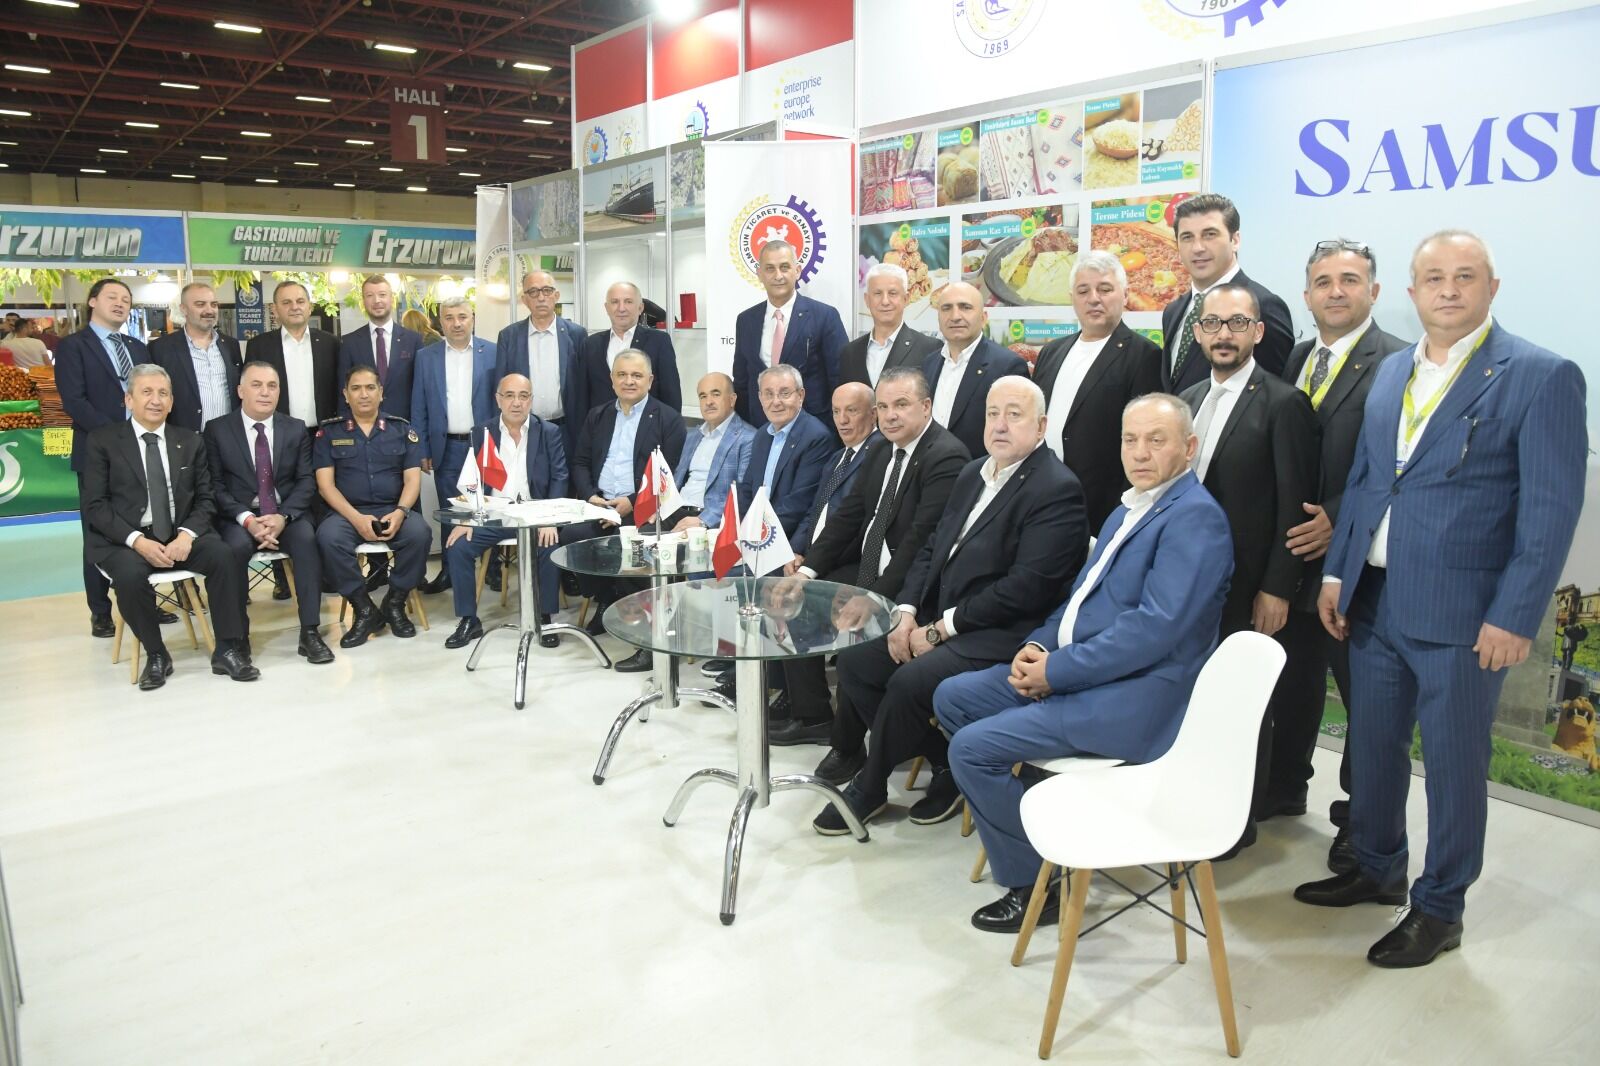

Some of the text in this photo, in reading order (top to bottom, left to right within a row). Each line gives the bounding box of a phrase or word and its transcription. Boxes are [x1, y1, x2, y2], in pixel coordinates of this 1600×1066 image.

[984, 39, 1009, 55] 1969
[783, 76, 822, 95] enterprise
[394, 87, 441, 107] HALL
[783, 94, 811, 109] europe
[783, 104, 815, 120] network
[407, 114, 428, 160] 1
[1094, 208, 1145, 221] Terme Pidesi
[0, 224, 142, 258] rzurum
[234, 225, 341, 244] GASTRONOMİ VE
[244, 243, 335, 263] TURİZM KENTİ
[742, 233, 760, 269] SAMSUN
[798, 247, 810, 265] ODA
[1025, 325, 1075, 336] Samsun Simidi
[720, 336, 736, 345] TİC
